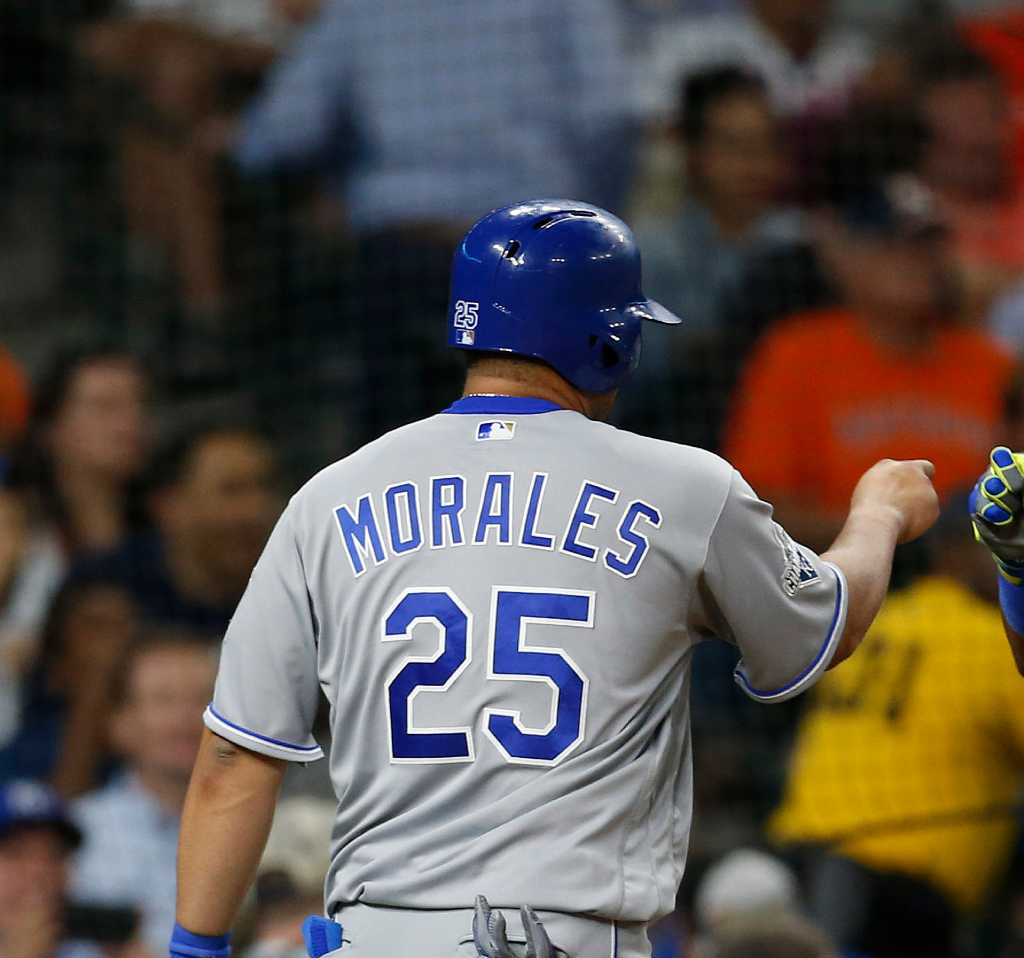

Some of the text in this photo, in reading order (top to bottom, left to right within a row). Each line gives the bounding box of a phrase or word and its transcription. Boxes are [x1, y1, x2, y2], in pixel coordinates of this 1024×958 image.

[454, 299, 479, 330] 25
[332, 472, 662, 579] MORALES
[381, 585, 597, 767] 25
